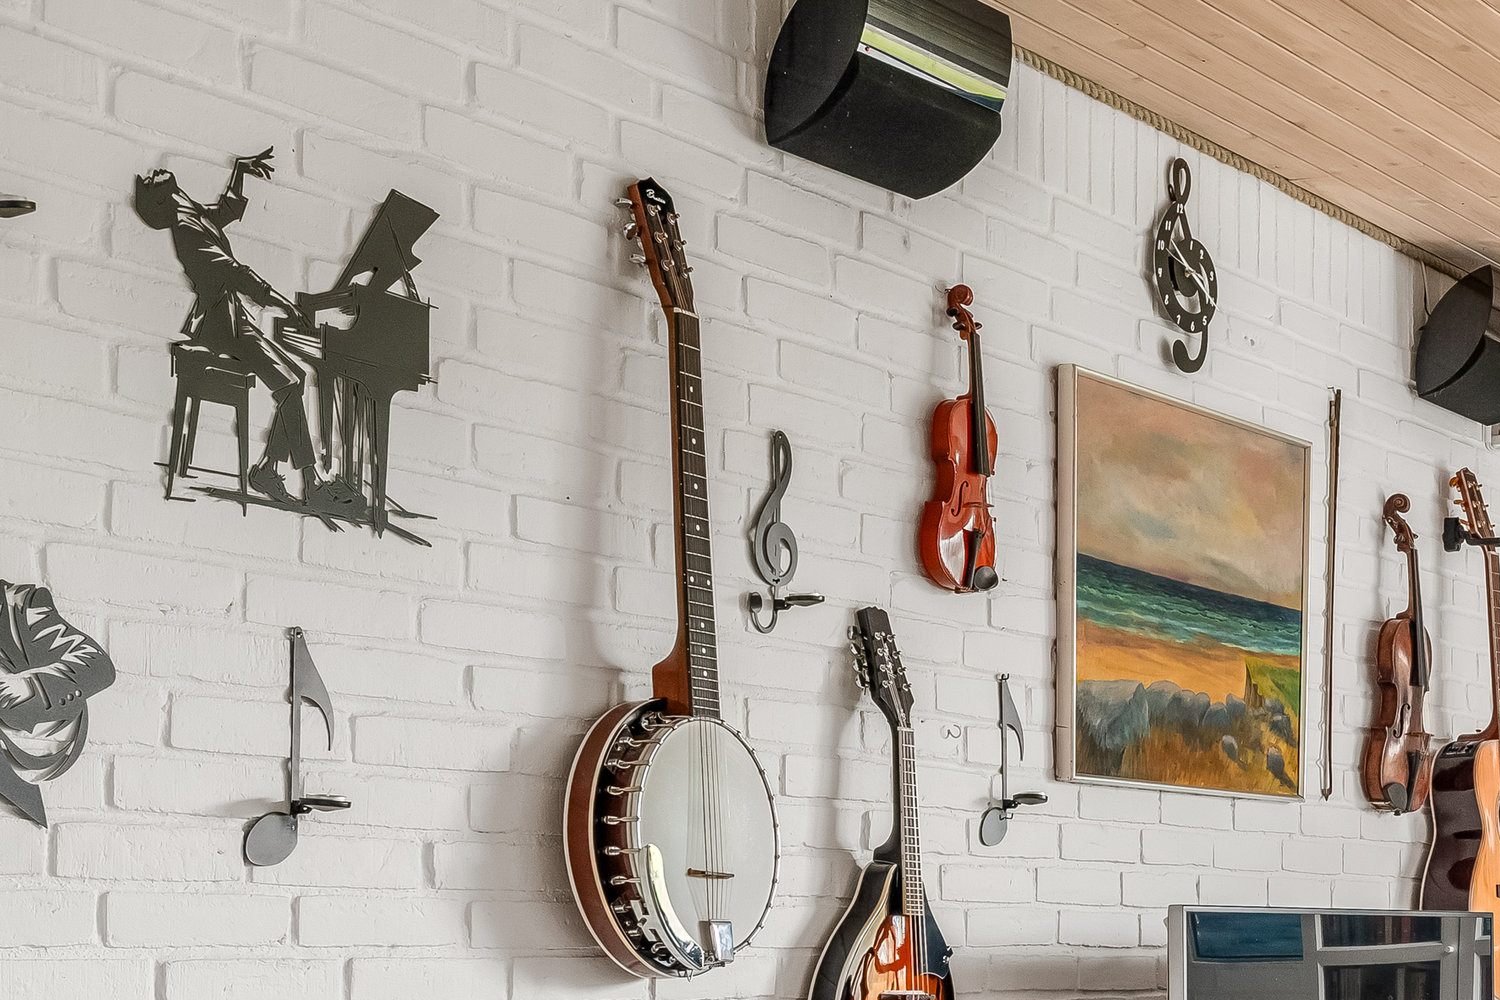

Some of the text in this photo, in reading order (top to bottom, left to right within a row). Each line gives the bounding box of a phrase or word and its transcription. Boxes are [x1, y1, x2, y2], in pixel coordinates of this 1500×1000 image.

[1176, 203, 1184, 214] 12
[1165, 221, 1172, 231] 11
[1158, 239, 1165, 250] 10
[1190, 241, 1193, 250] 1
[1199, 250, 1204, 260] 2
[1158, 268, 1163, 278] 9
[1209, 271, 1214, 281] 3
[1165, 295, 1169, 305] 8
[1176, 315, 1181, 325] 7
[1202, 316, 1208, 326] 5
[1190, 321, 1195, 332] 6
